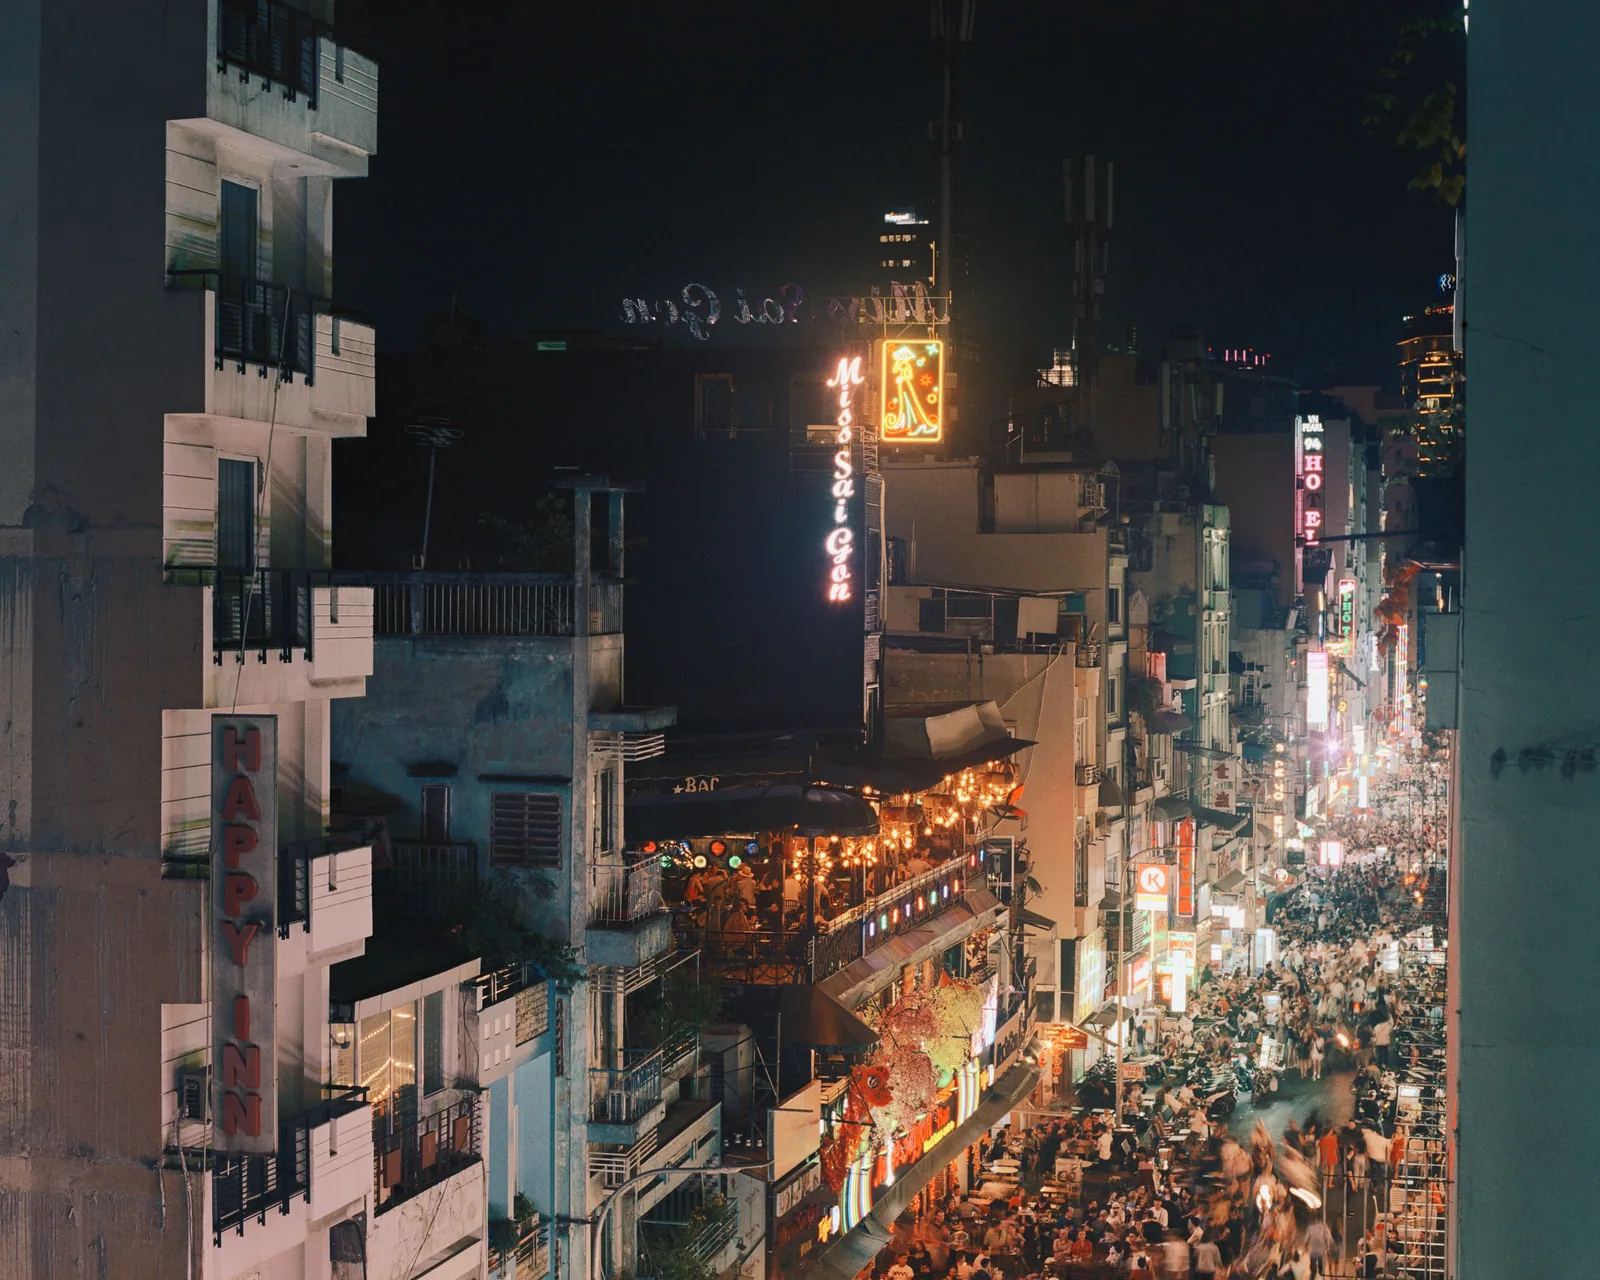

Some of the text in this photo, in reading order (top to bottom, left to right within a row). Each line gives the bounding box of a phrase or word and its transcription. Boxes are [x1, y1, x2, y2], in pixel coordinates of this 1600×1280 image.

[827, 356, 864, 444] Miss
[1304, 455, 1323, 546] HOTEL
[1148, 873, 1162, 891] K
[221, 725, 262, 1138] HAPPY INN
